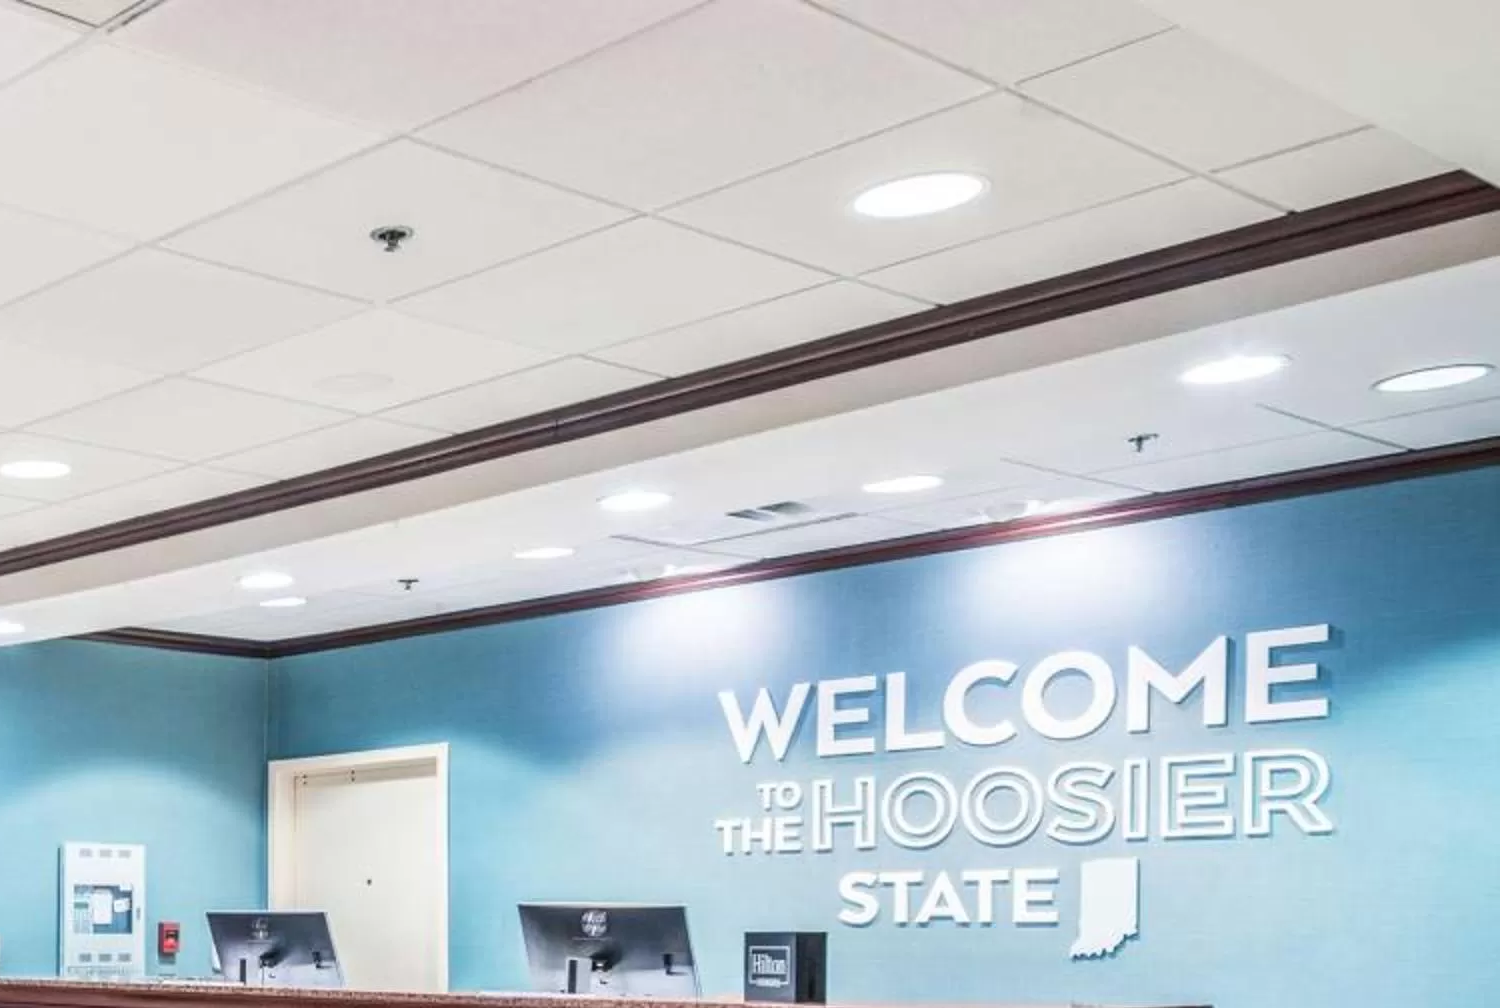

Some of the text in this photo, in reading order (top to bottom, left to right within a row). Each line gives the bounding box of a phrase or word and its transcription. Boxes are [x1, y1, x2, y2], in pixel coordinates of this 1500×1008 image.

[717, 623, 1331, 764] WELCOME
[714, 748, 1335, 855] THE HOOSIER
[756, 780, 802, 810] TO
[837, 866, 1060, 926] STATE
[752, 953, 786, 975] Hilton
